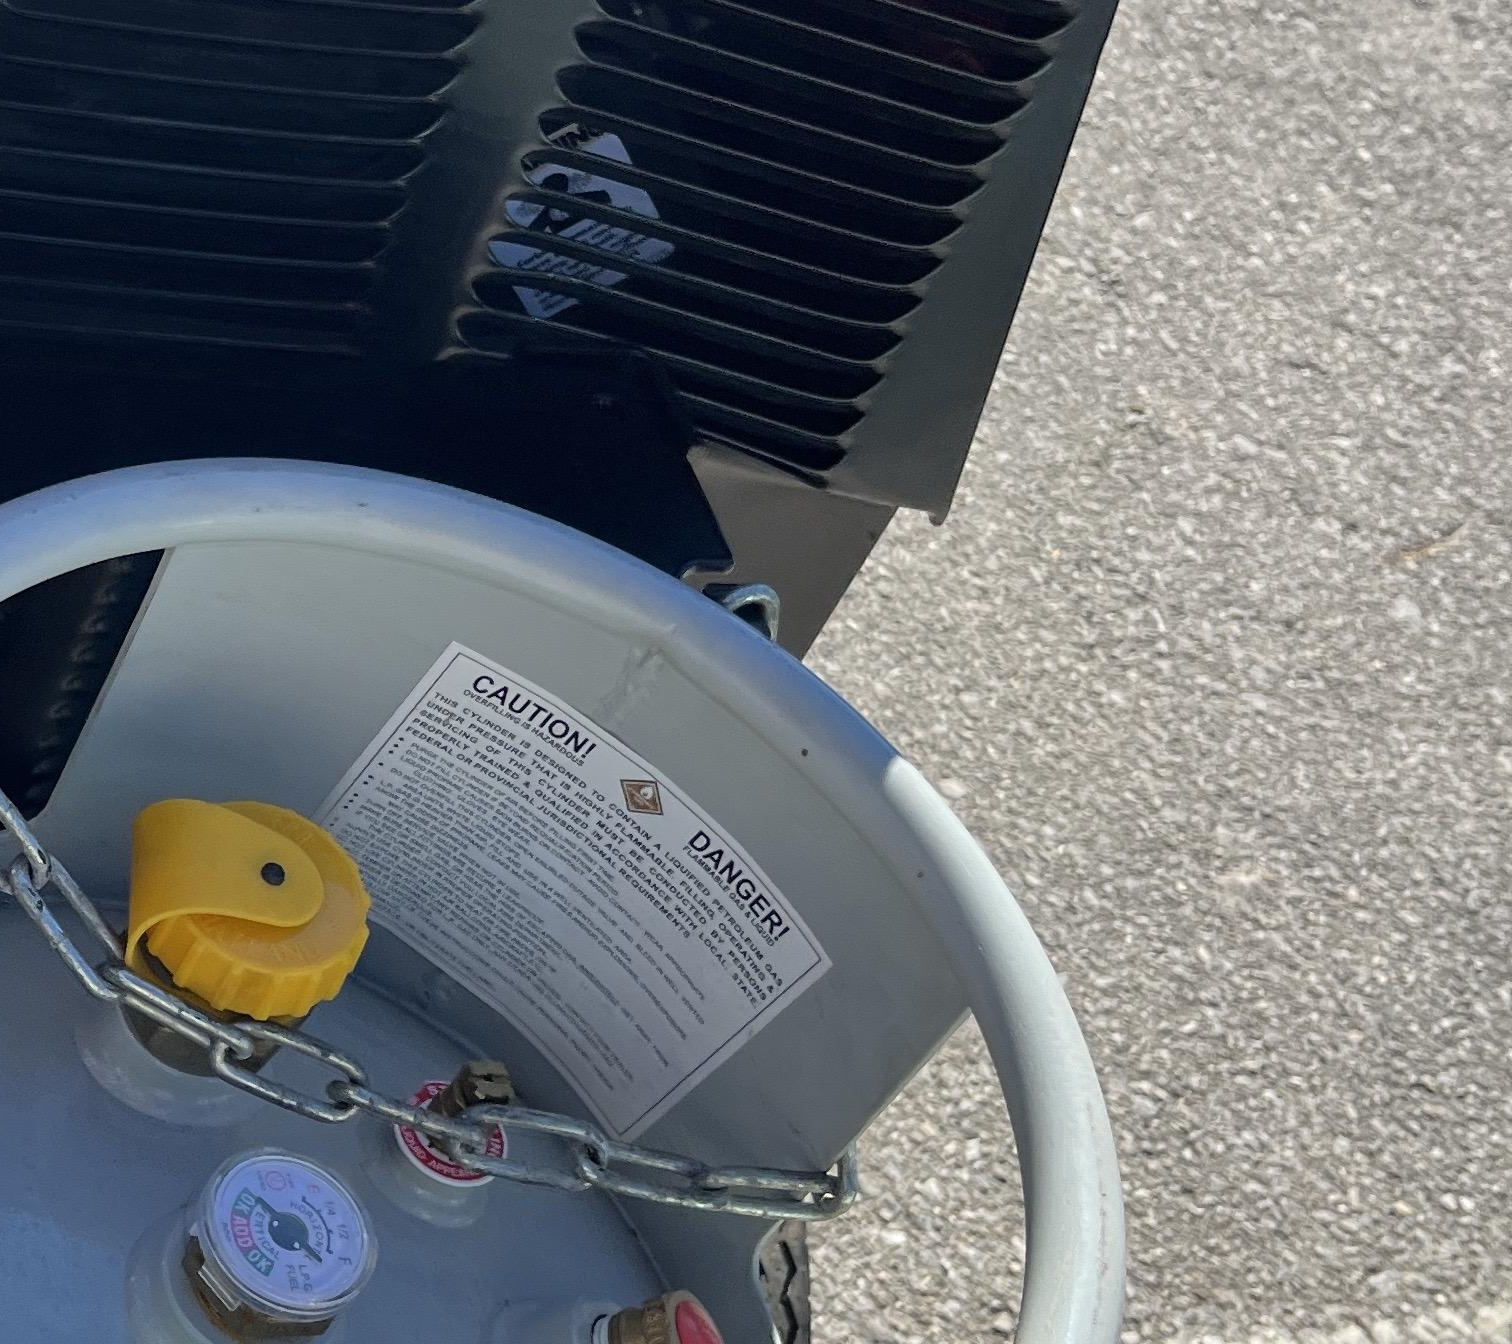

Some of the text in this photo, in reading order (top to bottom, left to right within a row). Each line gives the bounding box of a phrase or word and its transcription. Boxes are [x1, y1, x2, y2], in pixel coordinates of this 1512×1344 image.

[462, 687, 585, 767] OVERFILLING IS HAZARDOUS
[472, 675, 597, 759] CAUTION!
[405, 725, 453, 754] FEDERAL
[455, 751, 473, 765] OR
[472, 762, 537, 806] PROVINCIAL
[536, 802, 619, 869] JURISDICTIONAL
[412, 717, 470, 752] PROPERLY
[473, 749, 520, 781] TRAINED
[522, 779, 531, 789] &
[533, 787, 588, 830] QUALIFIED
[591, 830, 602, 841] IN
[603, 841, 672, 904] ACCORDANCE
[673, 904, 698, 930] WITH
[425, 700, 464, 724] UNDER
[468, 722, 526, 759] PRESSURE
[529, 758, 558, 781] THAT
[559, 780, 571, 791] IS
[573, 790, 612, 821] HIGHLY
[717, 921, 767, 981] OPERATING
[766, 983, 775, 994] &
[433, 691, 458, 708] THIS
[462, 706, 517, 740] CYLINDER
[519, 739, 531, 749] IS
[534, 749, 587, 789] DESIGNED
[590, 788, 605, 802] TO
[607, 802, 652, 841] CONTAIN
[653, 841, 662, 851] A
[663, 851, 711, 897] LIQUIFIED
[711, 897, 764, 961] PETROLEUM
[763, 962, 784, 987] GAS
[418, 708, 768, 1001] SERVICING OF THIS CYLINDER MUST BE CONDUCTED BY PERSONS
[681, 844, 730, 892] FLAMMABLE
[727, 891, 746, 911] GAS
[749, 917, 776, 947] LIQUID
[688, 830, 791, 942] DANGER!
[232, 1215, 251, 1248] ADD
[235, 1193, 255, 1216] OK
[250, 1250, 273, 1275] OK
